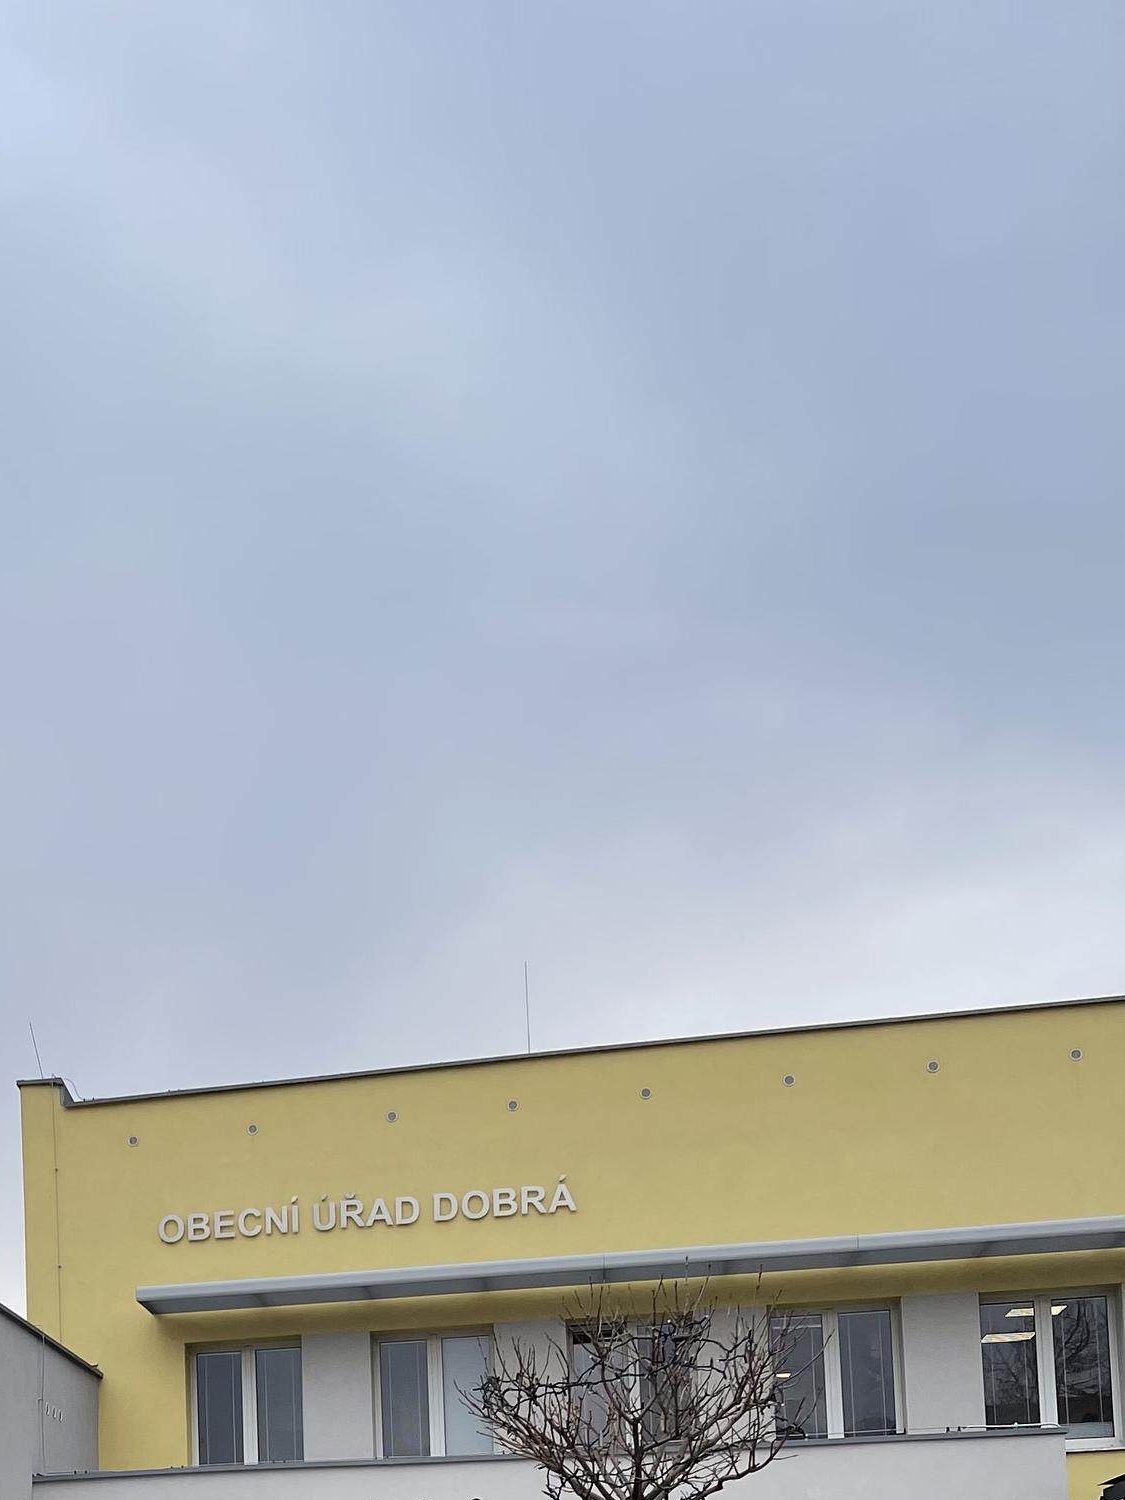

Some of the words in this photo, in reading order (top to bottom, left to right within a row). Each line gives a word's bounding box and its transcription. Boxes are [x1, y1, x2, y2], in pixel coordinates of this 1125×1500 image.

[158, 1196, 299, 1243] OBECNÍ
[313, 1193, 420, 1232] ÚŘAD
[433, 1174, 577, 1222] DOBRÁ
